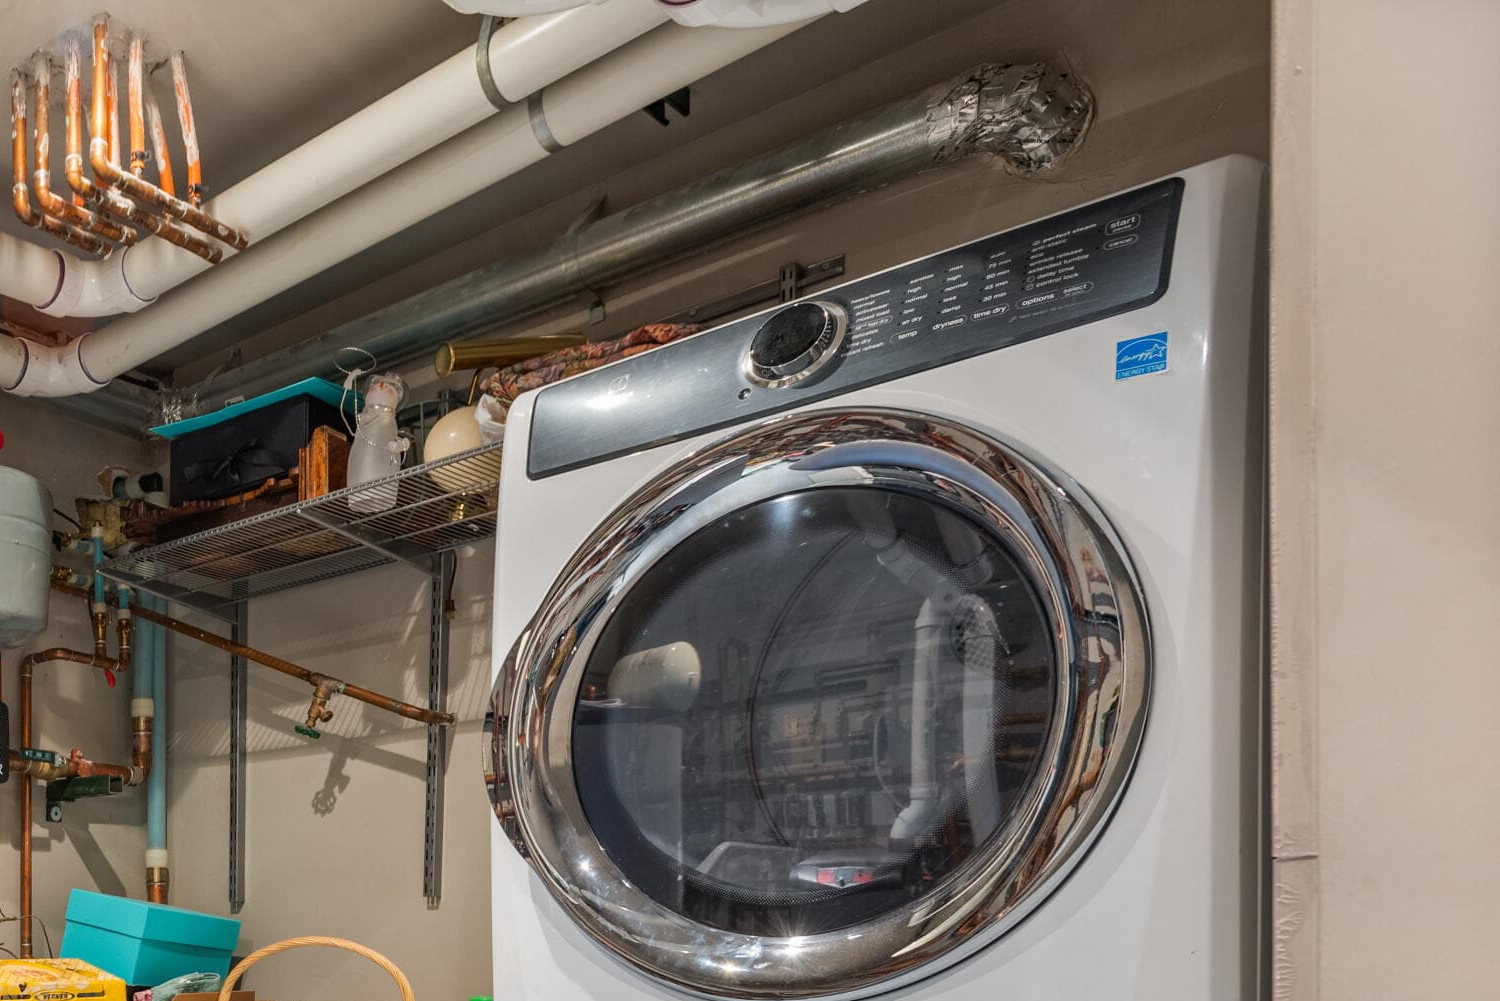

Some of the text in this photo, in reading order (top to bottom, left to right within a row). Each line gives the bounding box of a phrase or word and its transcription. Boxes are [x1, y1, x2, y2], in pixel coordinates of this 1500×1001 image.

[1109, 216, 1136, 229] start
[1042, 223, 1097, 244] perfect steam
[1108, 237, 1134, 248] cancel
[1028, 254, 1090, 275] extended tumble
[1037, 266, 1075, 280] delay time
[944, 281, 969, 292] normal
[1036, 273, 1079, 288] control lock
[905, 293, 928, 304] normal
[1022, 293, 1056, 306] options
[1063, 283, 1088, 294] select
[941, 305, 961, 314] damp
[973, 306, 1008, 319] time dry
[932, 317, 964, 331] dryness
[898, 330, 918, 341] temp
[1117, 362, 1166, 379] ENERGY STAR
[41, 992, 69, 1001] WERNER
